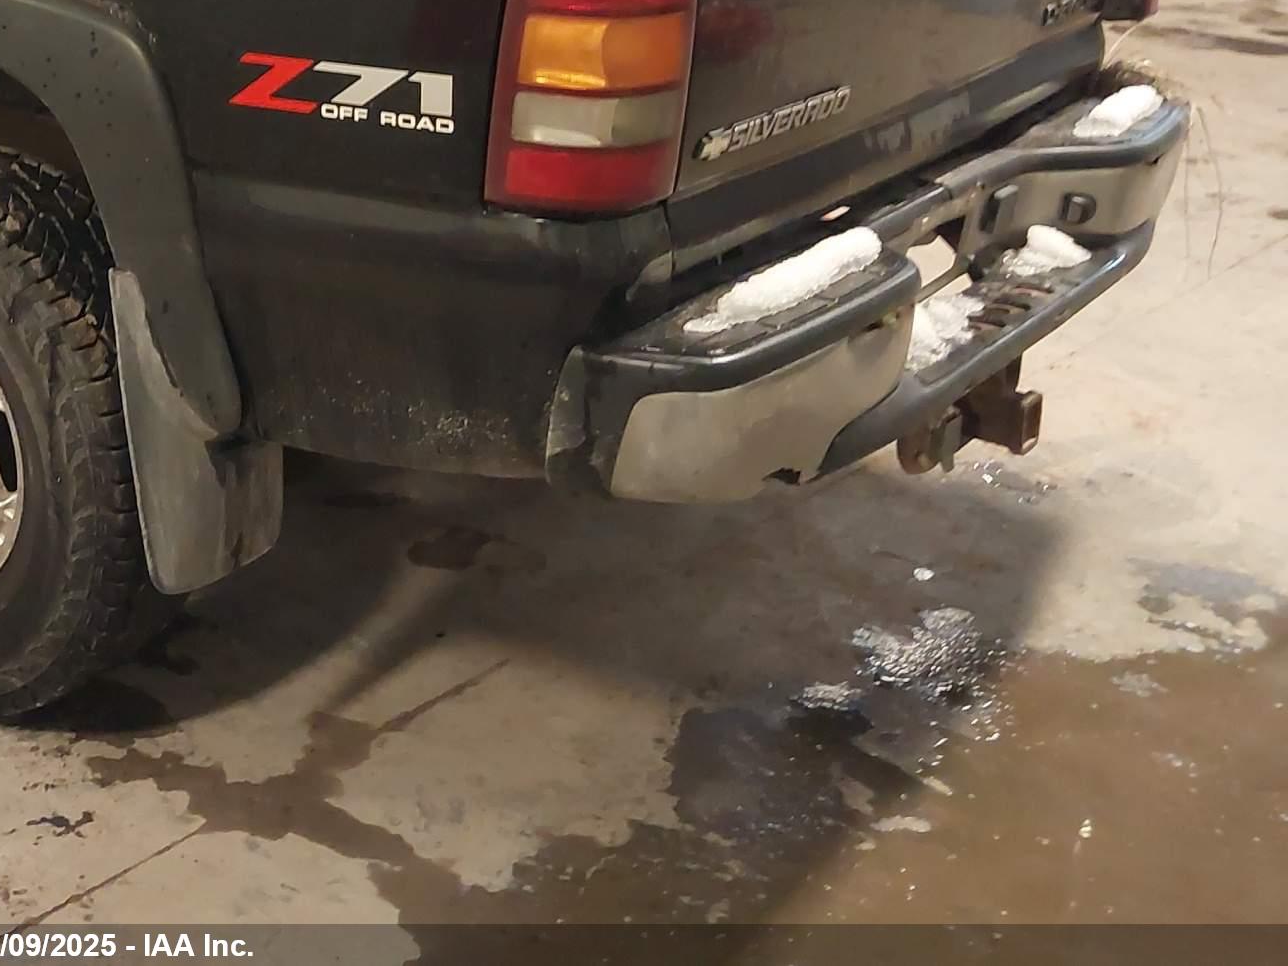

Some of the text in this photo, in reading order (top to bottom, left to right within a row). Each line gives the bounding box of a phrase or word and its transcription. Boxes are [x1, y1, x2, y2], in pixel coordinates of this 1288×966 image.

[228, 52, 454, 118] Z71
[320, 102, 455, 134] OFF ROAD
[727, 85, 852, 153] SILVERADO
